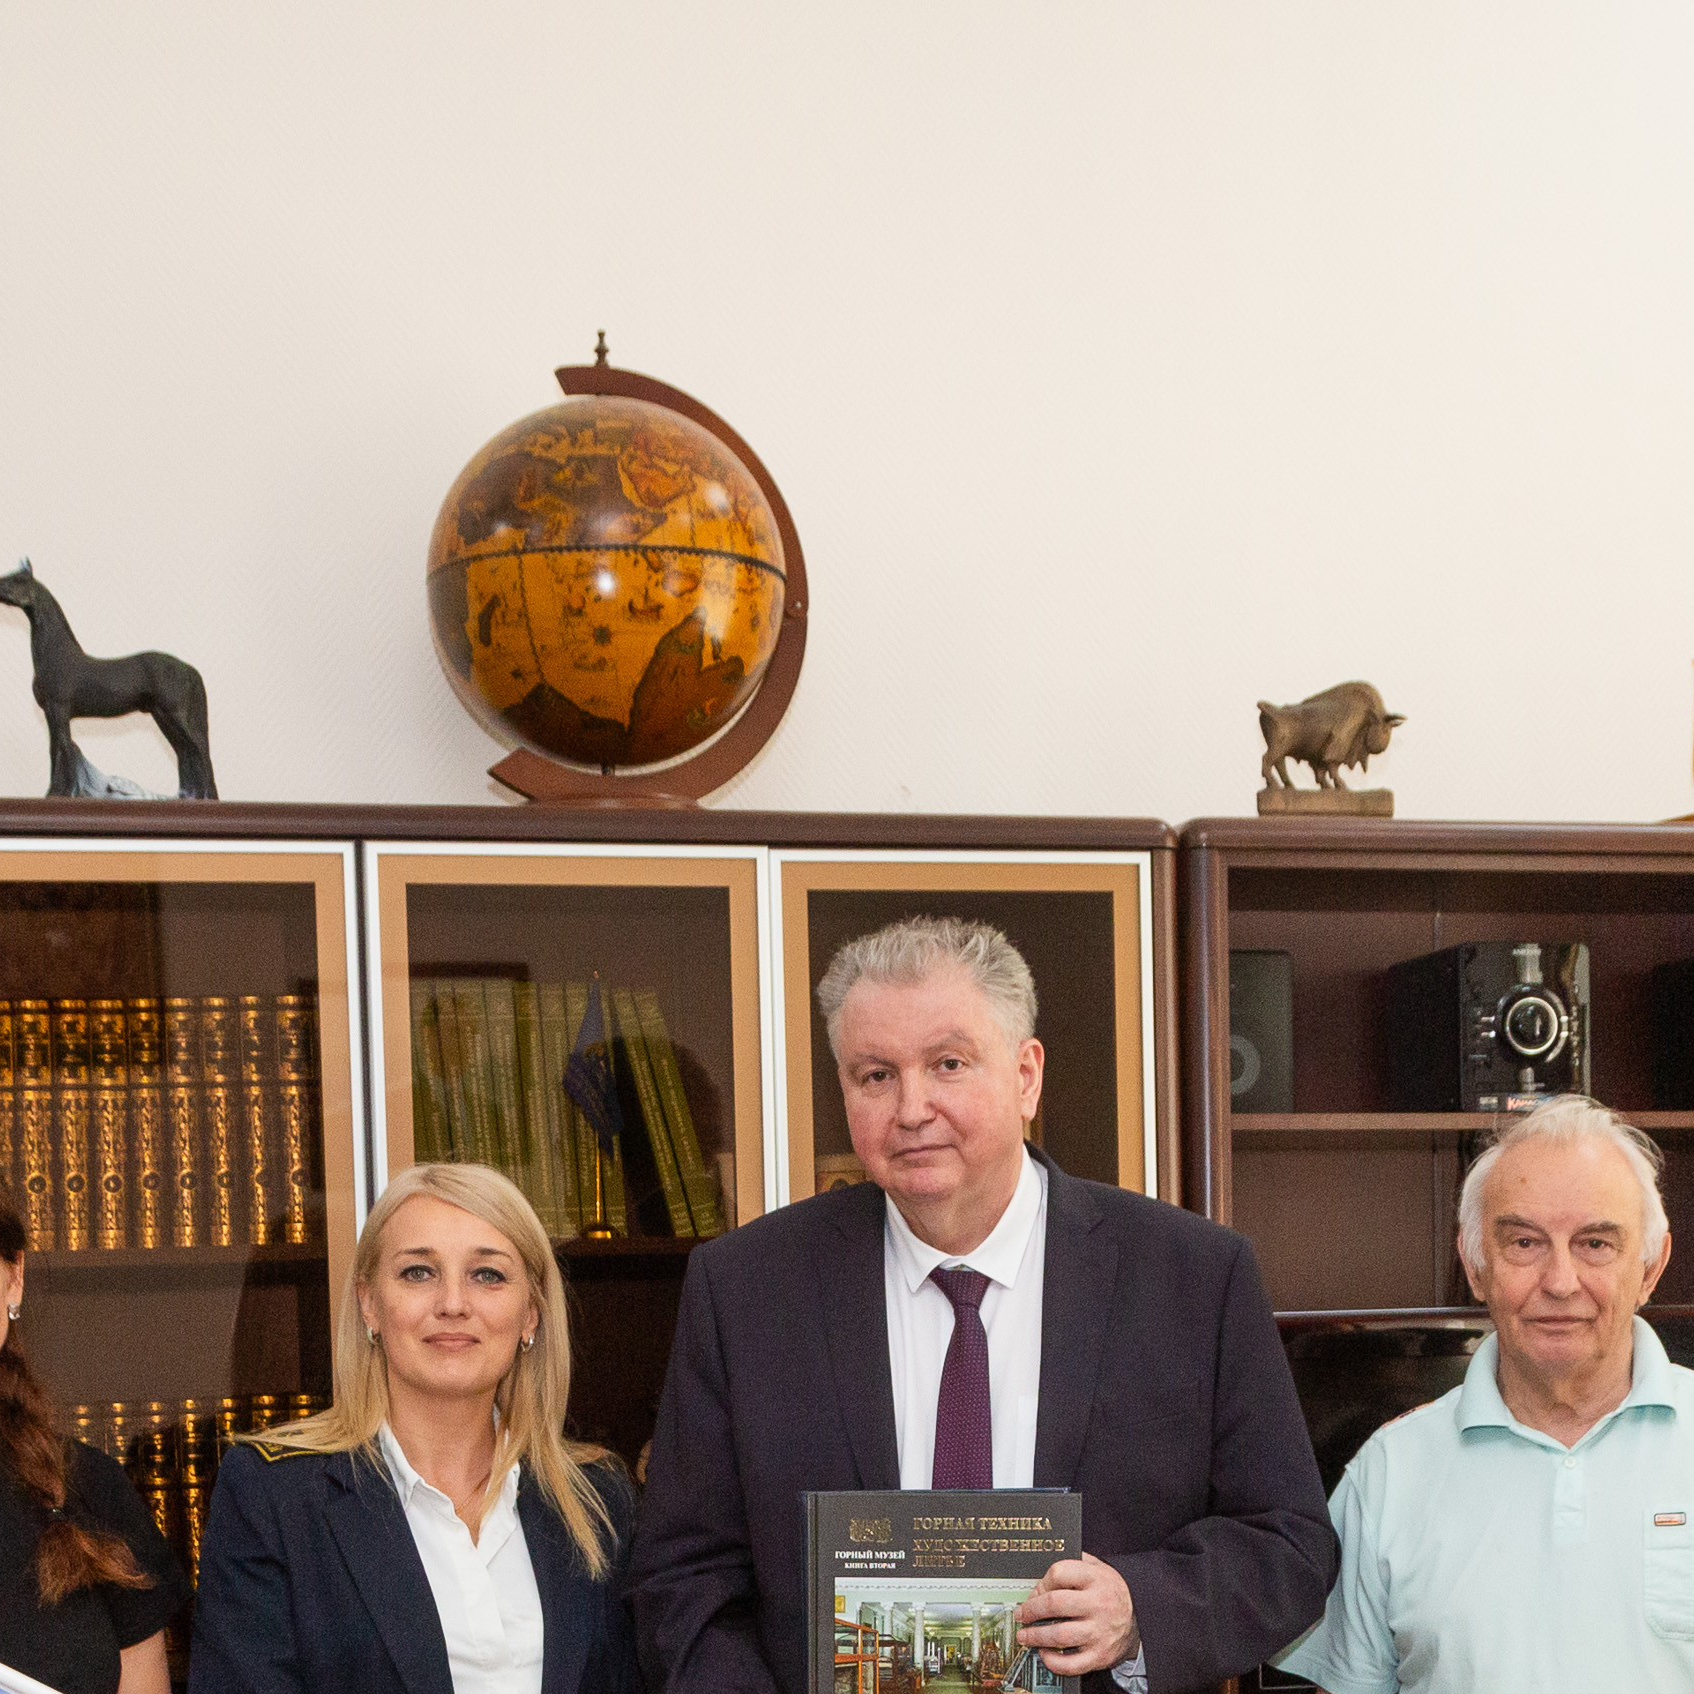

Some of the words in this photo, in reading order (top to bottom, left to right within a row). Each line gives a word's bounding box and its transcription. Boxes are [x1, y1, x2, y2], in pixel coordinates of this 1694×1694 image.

[913, 1517, 975, 1530] ГОРНАЯ
[978, 1517, 1053, 1530] ТЕХНИКА
[912, 1538, 1065, 1552] ХУДОЖЕСТВЕННОЕ
[835, 1550, 873, 1560] ГОРНЫЙ
[874, 1550, 906, 1560] МУЗЕЙ
[912, 1555, 966, 1567] ЛИТЬЕ
[844, 1562, 868, 1570] КНИГА
[869, 1562, 896, 1570] ВТОРАЯ
